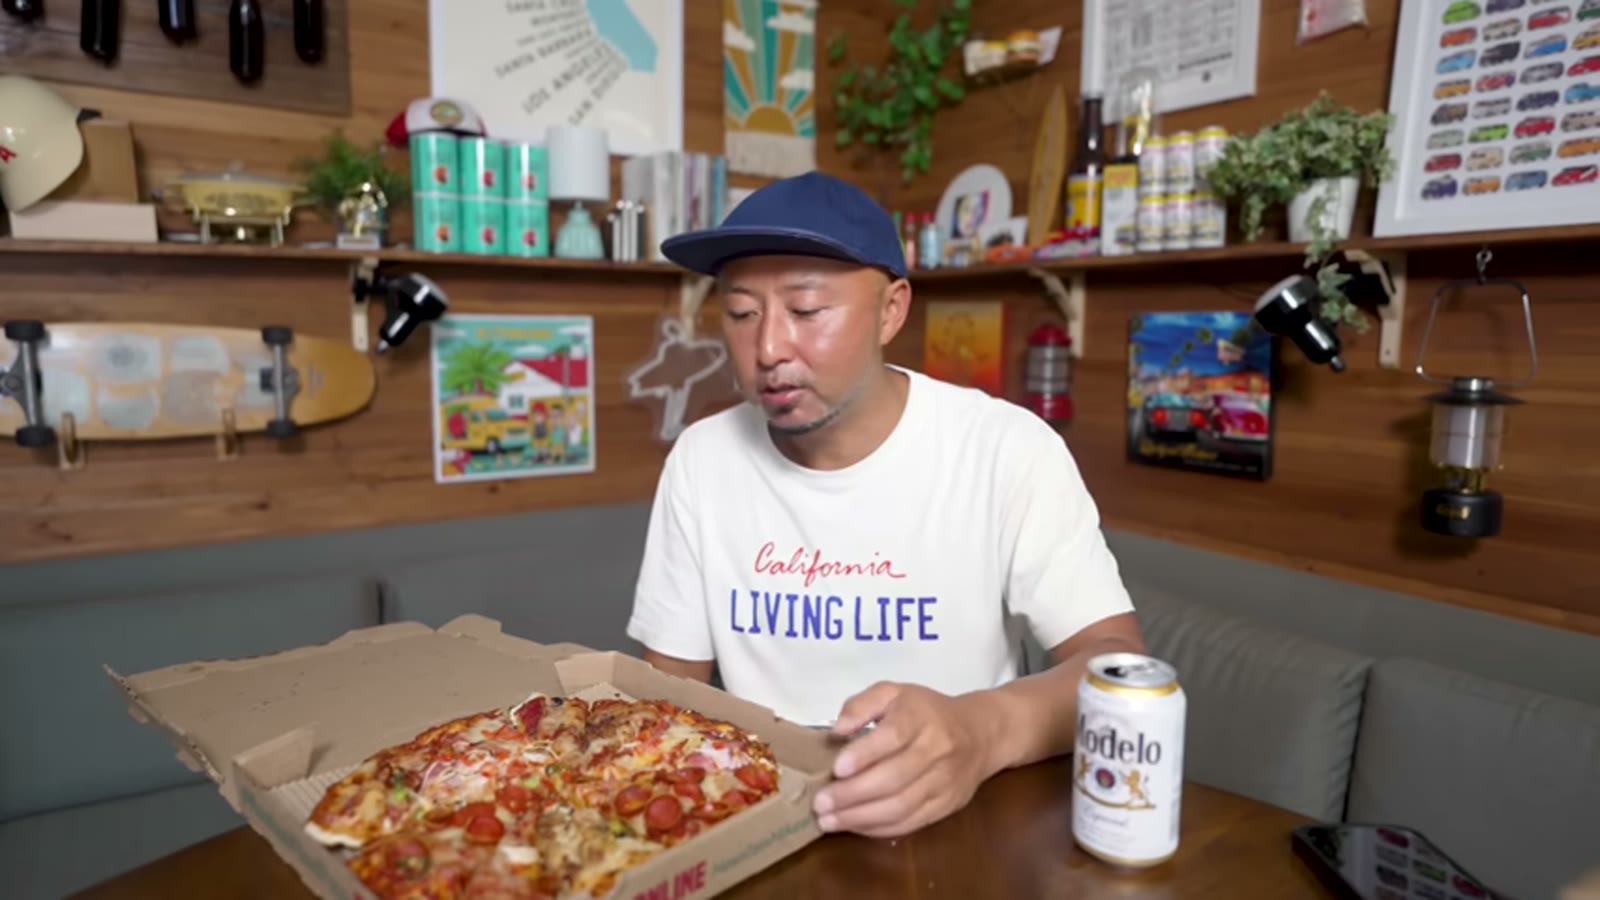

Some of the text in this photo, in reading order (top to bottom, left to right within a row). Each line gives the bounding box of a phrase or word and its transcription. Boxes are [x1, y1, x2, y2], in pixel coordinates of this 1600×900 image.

[494, 53, 535, 80] SANTA
[522, 87, 550, 115] LOS
[753, 541, 907, 588] California
[731, 588, 940, 641] LIVING LIFE
